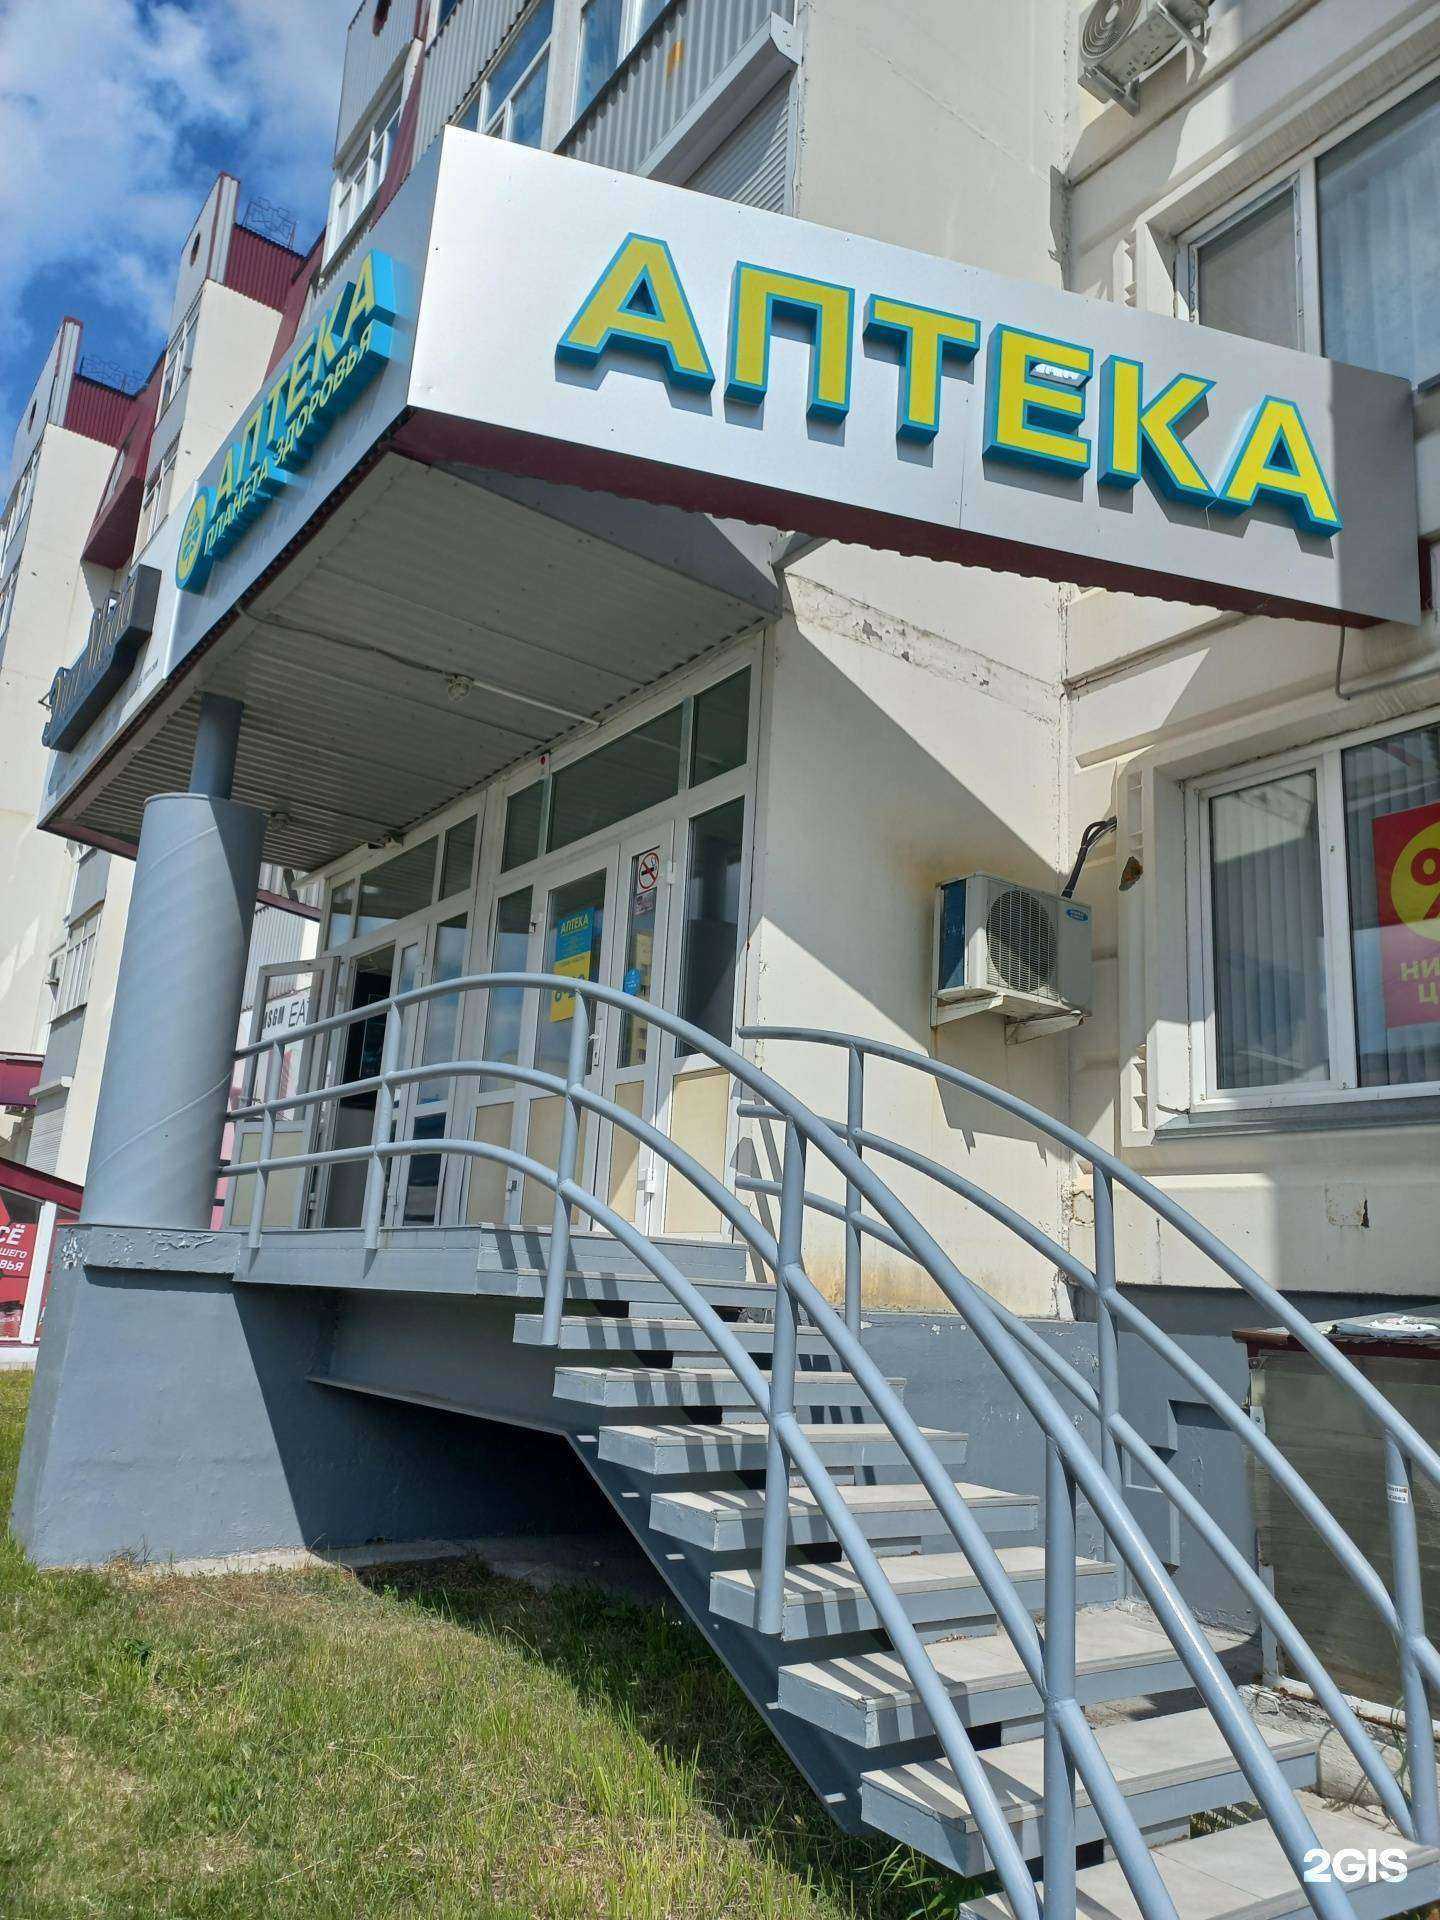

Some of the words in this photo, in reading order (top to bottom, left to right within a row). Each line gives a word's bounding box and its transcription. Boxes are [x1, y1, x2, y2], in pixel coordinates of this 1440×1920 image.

[211, 250, 382, 518] АПТЕКА
[274, 323, 373, 467] ЗДОРОВЬЯ
[555, 232, 1342, 536] АПТЕКА
[203, 455, 270, 556] ПЛАНЕТА
[560, 912, 590, 936] АПТЕКА
